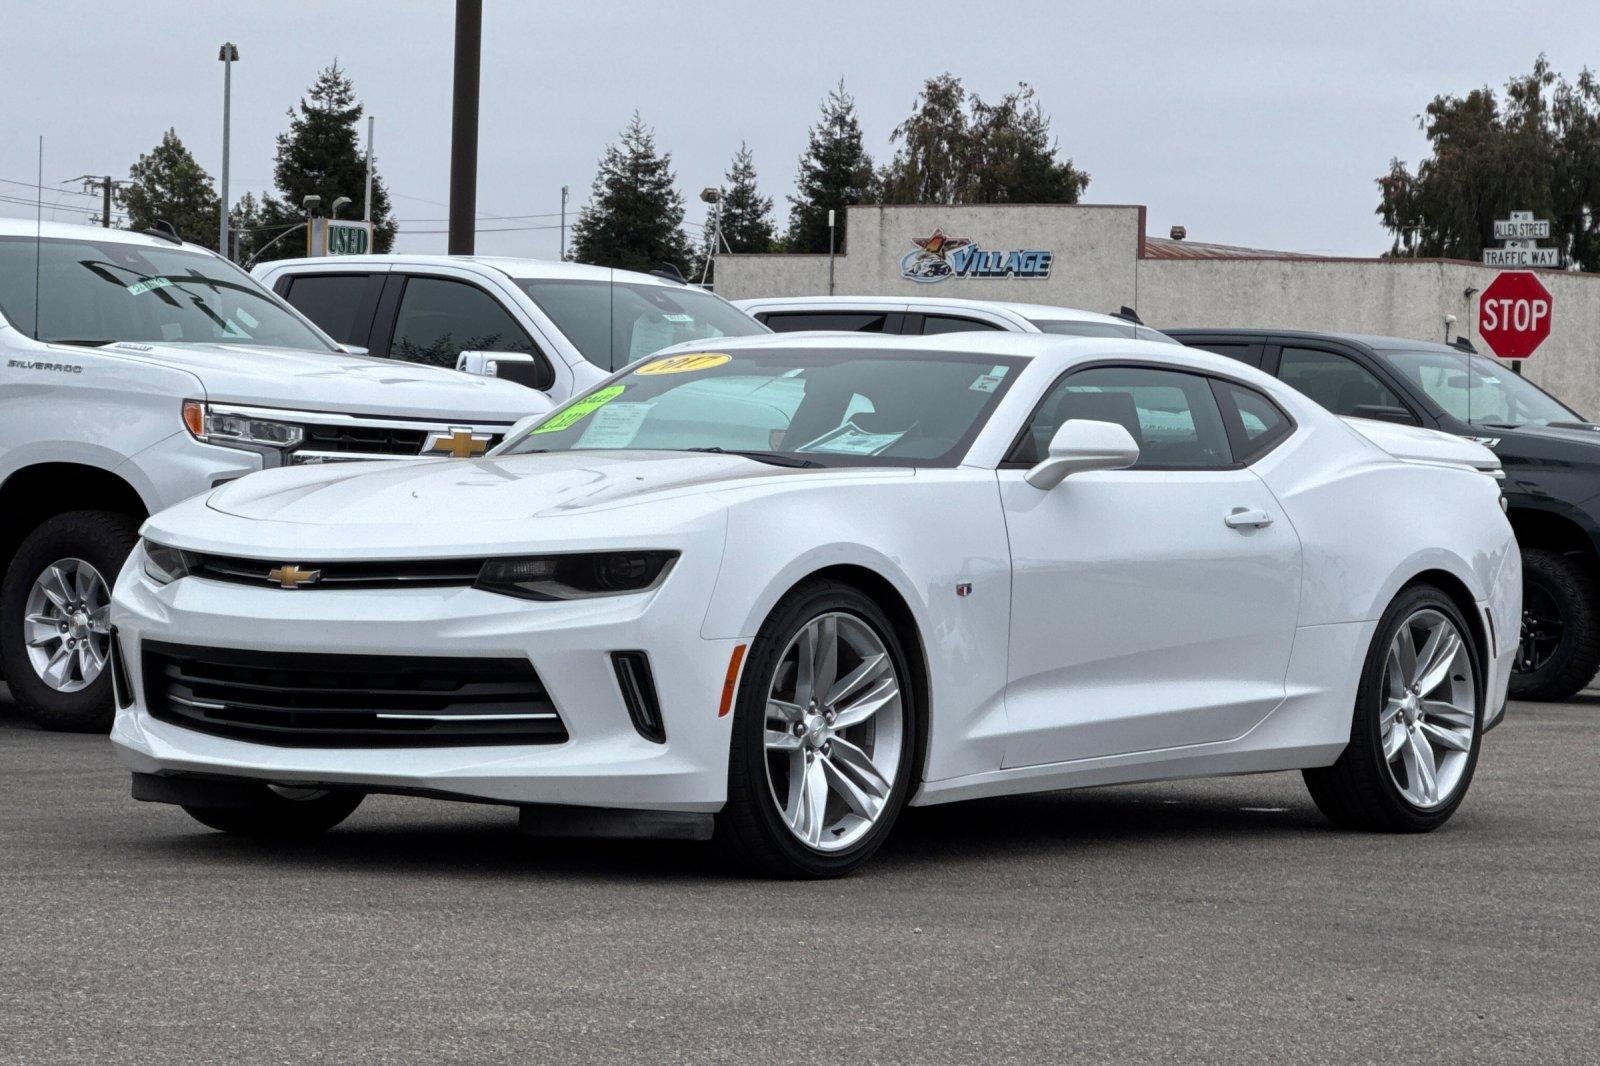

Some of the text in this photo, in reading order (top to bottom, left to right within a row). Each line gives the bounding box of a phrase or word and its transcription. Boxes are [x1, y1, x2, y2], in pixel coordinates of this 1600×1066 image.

[328, 225, 368, 255] USED
[1495, 223, 1547, 237] ALLEN STREET
[952, 243, 1051, 277] VILLAGE
[1485, 251, 1554, 265] TRAFFIC WAY
[1482, 298, 1548, 332] STOP
[7, 358, 83, 374] SILVERADO
